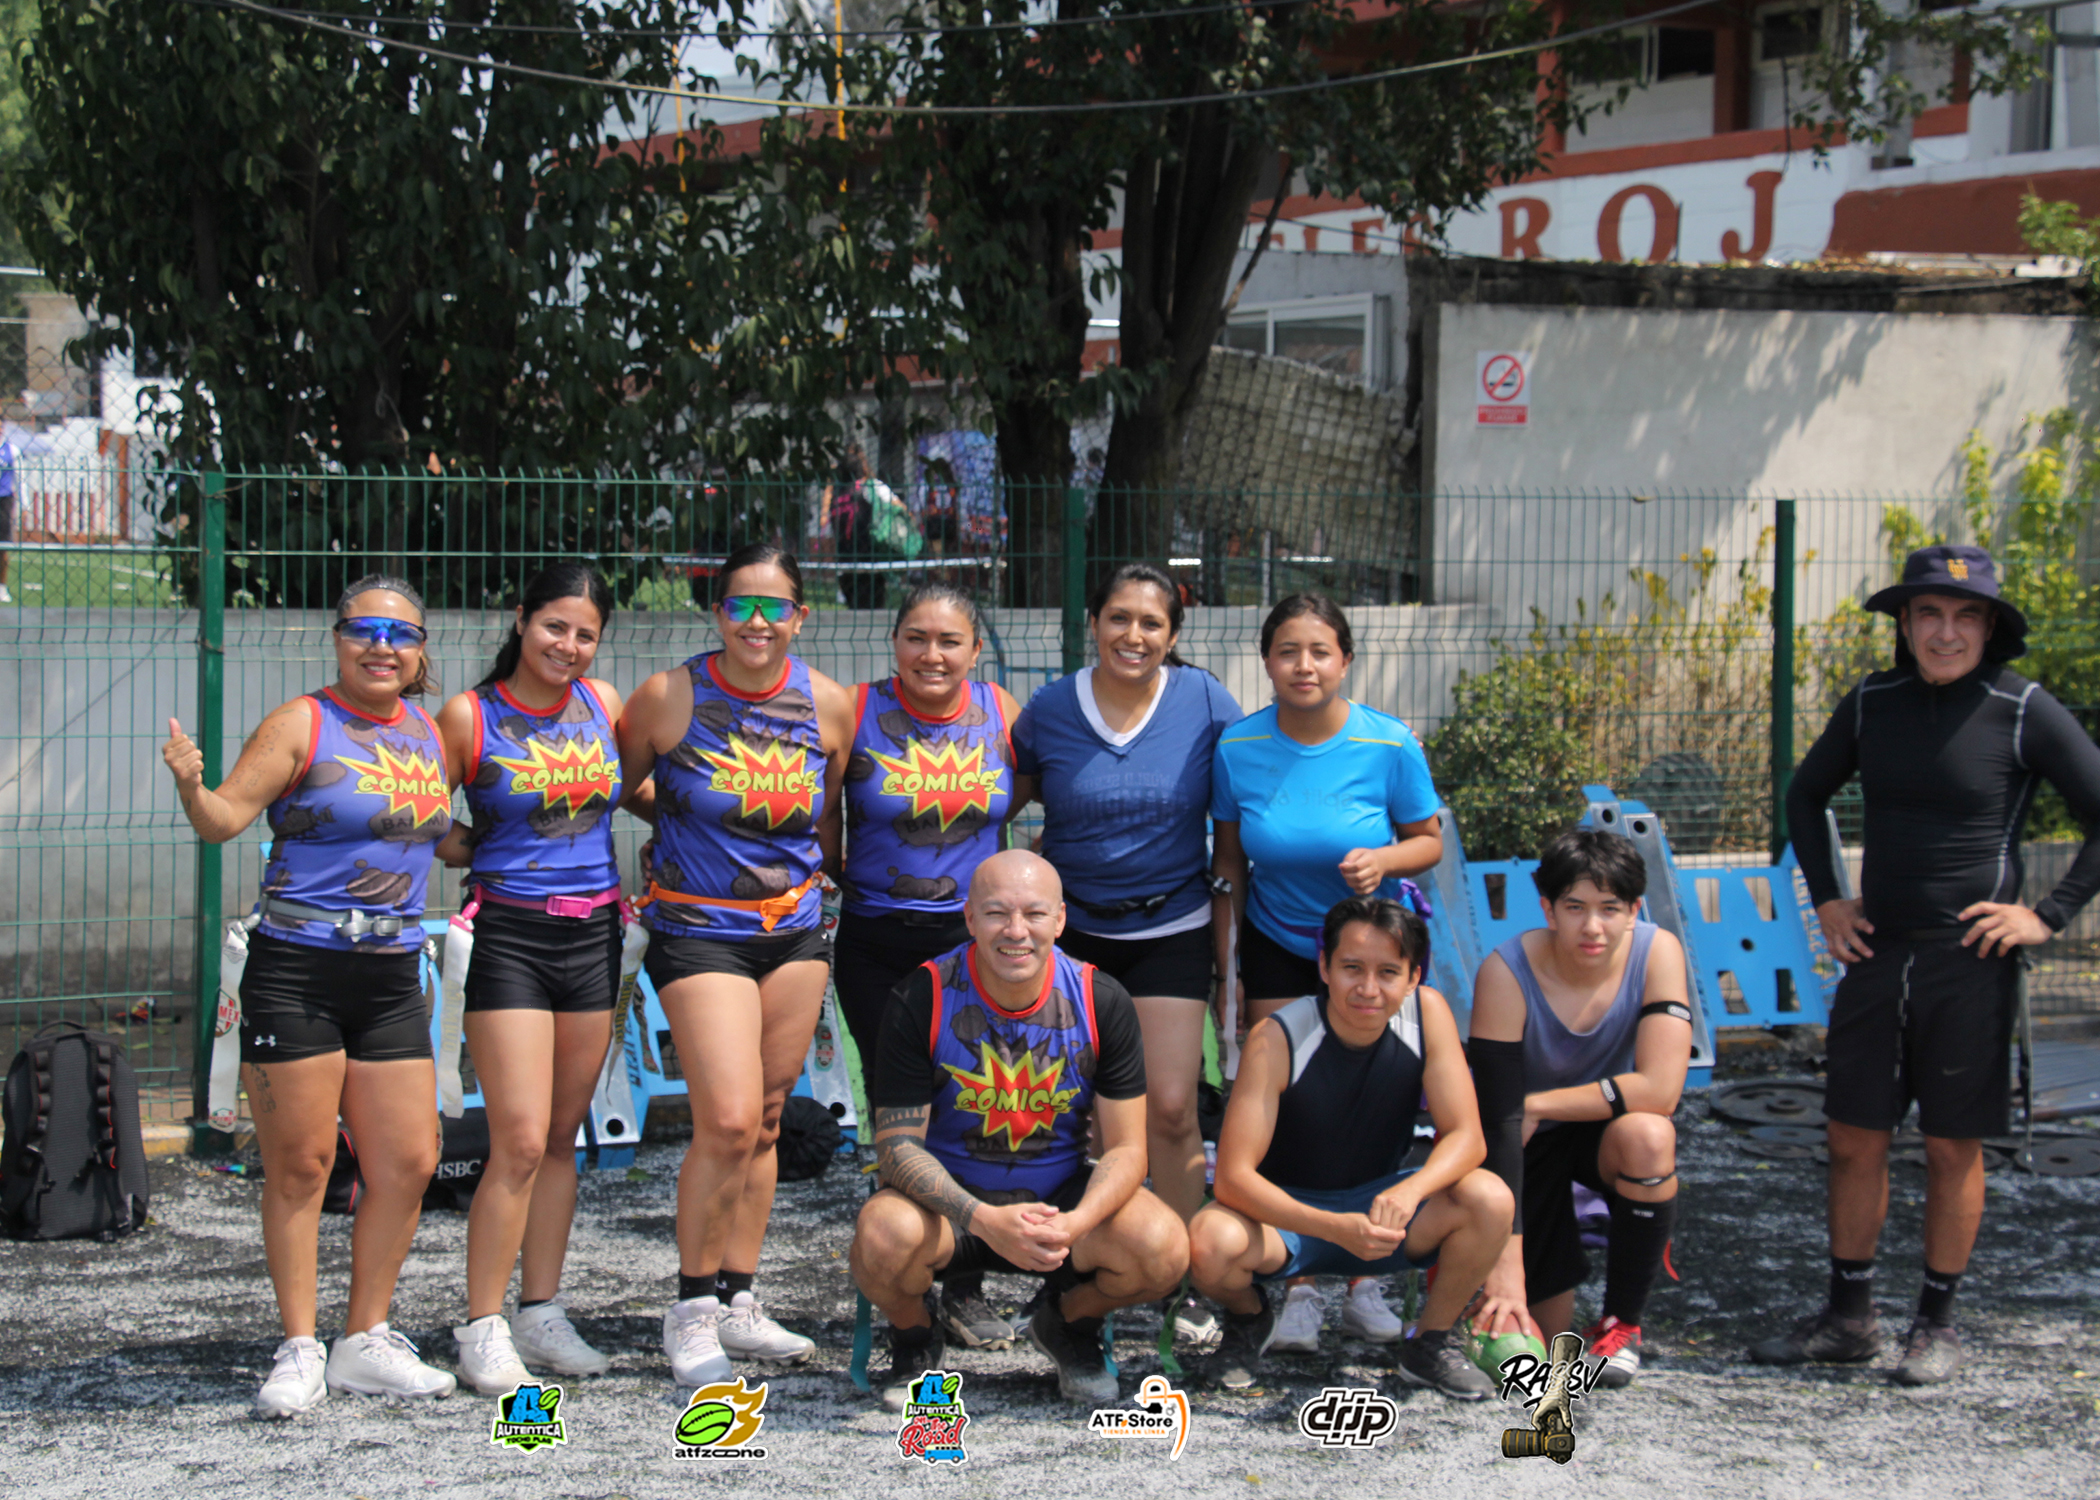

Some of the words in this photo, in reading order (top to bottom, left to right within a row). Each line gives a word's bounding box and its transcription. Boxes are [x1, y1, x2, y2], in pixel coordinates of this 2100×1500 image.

[357, 774, 450, 801] COMICS
[510, 762, 616, 793] COMICS
[711, 768, 817, 794] COMICS
[882, 770, 997, 794] COMICS
[955, 1087, 1072, 1113] COMICS
